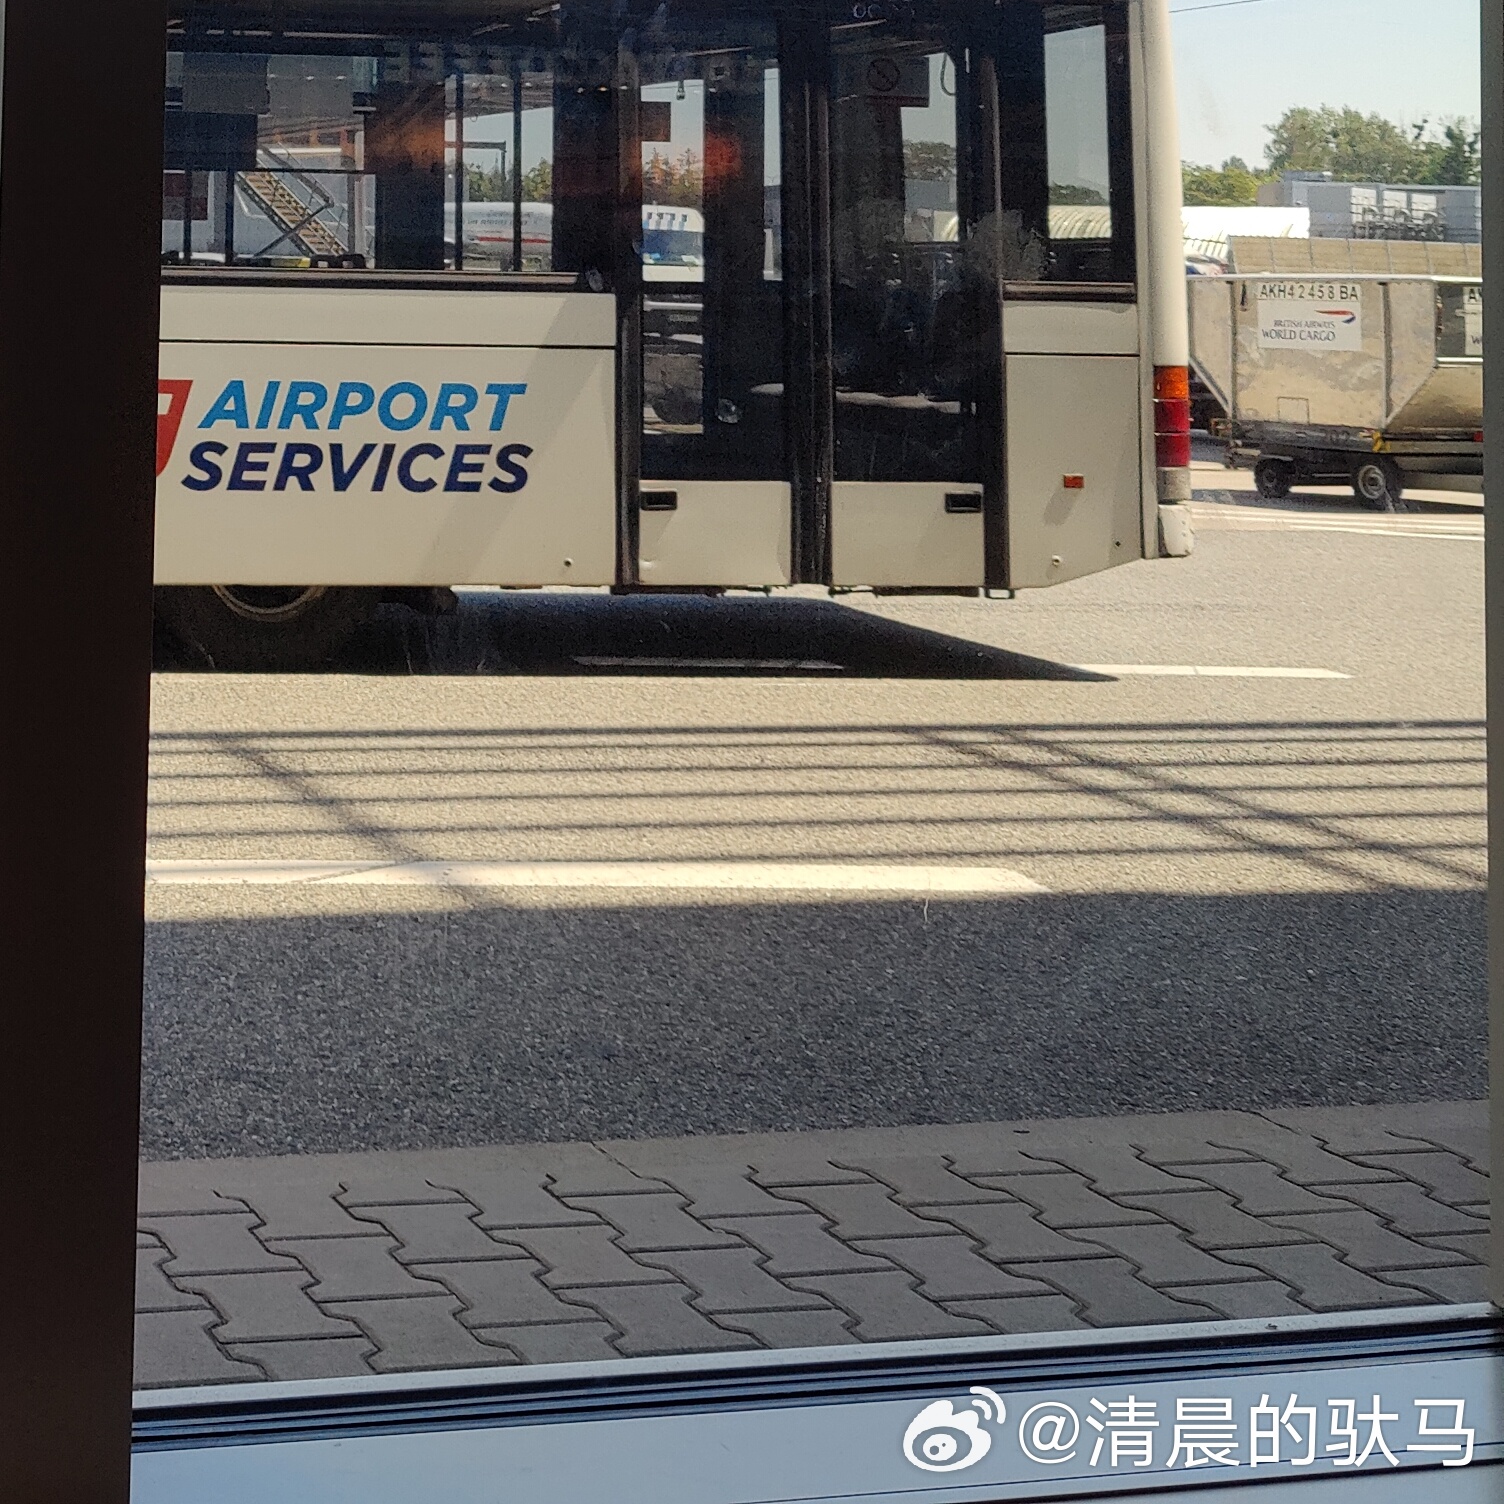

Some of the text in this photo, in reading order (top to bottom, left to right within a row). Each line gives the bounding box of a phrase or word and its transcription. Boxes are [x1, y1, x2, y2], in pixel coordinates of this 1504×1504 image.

[1262, 329, 1336, 342] WORLD CARGO
[1273, 319, 1335, 329] BRITISH AIRWAYS
[197, 380, 528, 432] AIRPORT
[180, 440, 534, 494] SERVICES
